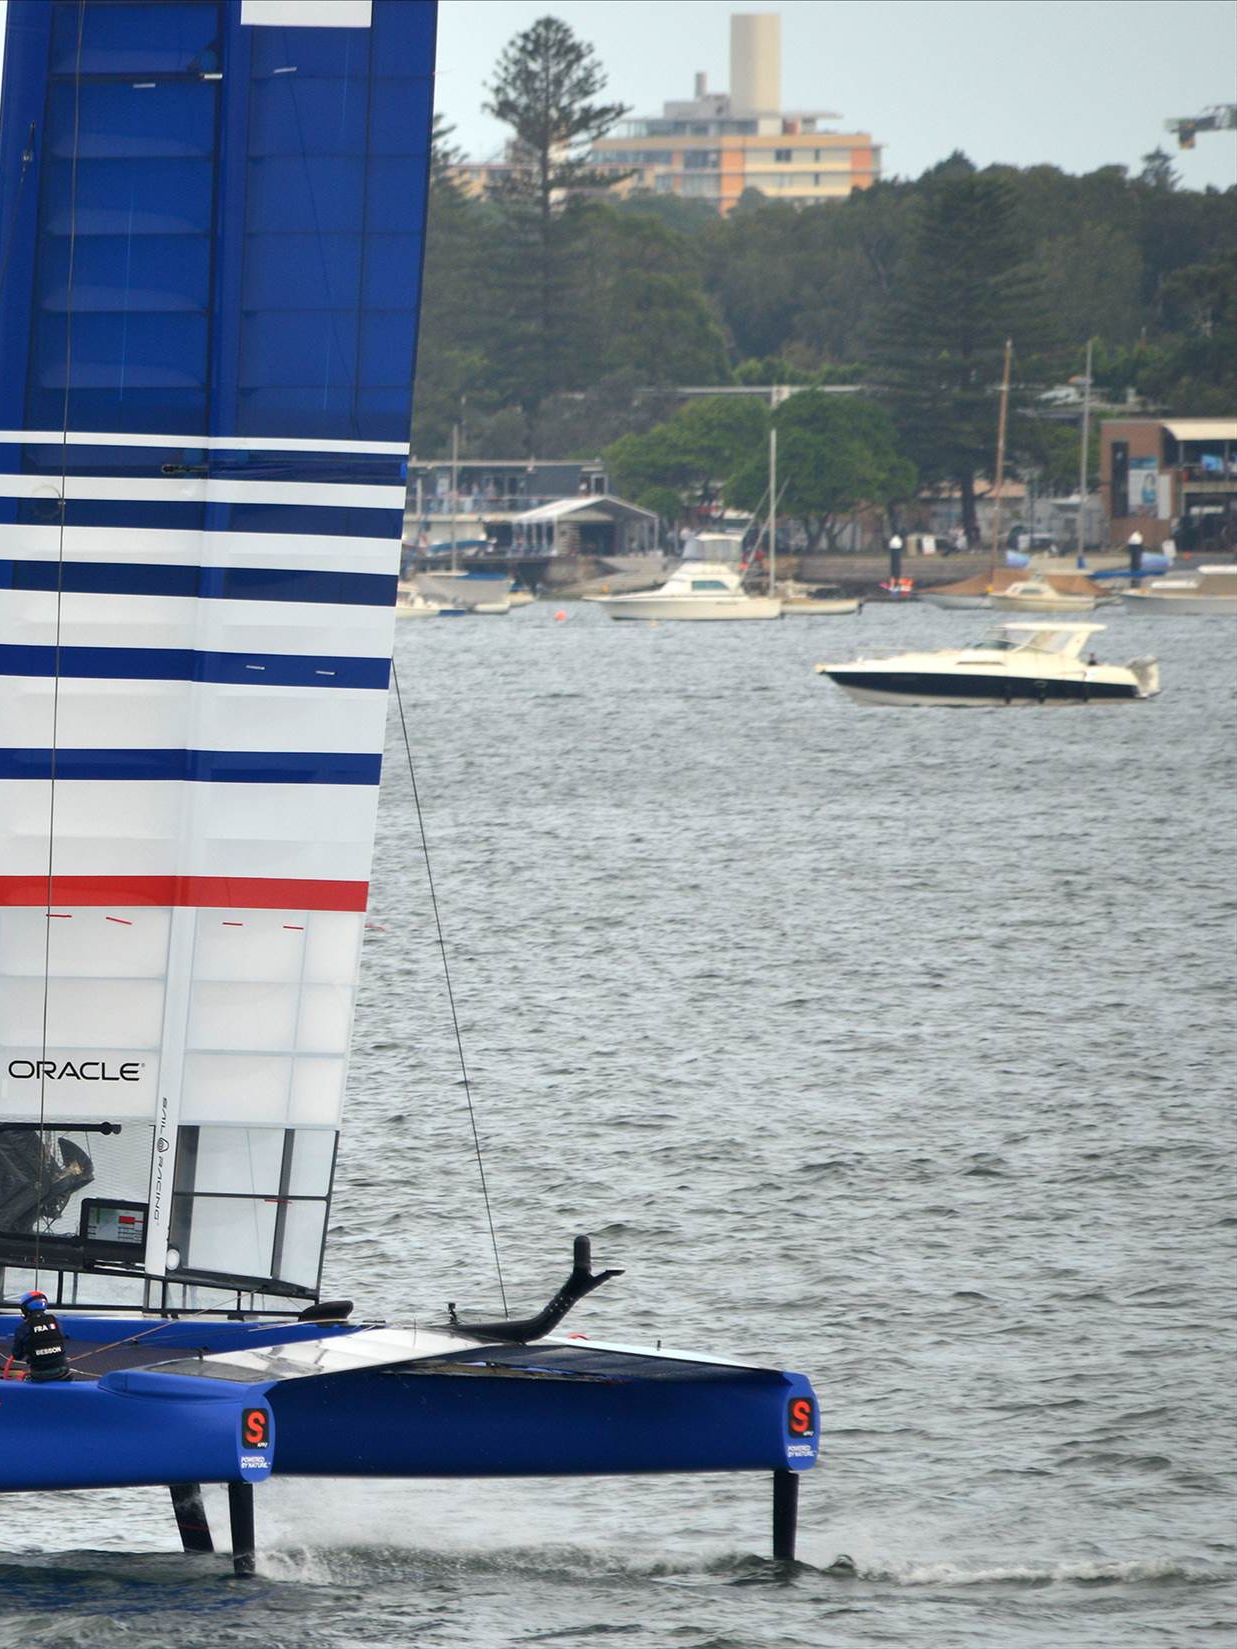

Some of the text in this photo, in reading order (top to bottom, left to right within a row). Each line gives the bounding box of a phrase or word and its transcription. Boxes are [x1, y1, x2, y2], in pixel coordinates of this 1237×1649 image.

[8, 1060, 140, 1081] ORACLE
[153, 1096, 168, 1221] SAIL RACING
[33, 1324, 49, 1333] FRA
[35, 1345, 62, 1357] BESSON
[245, 1411, 266, 1444] S
[792, 1399, 811, 1433] S
